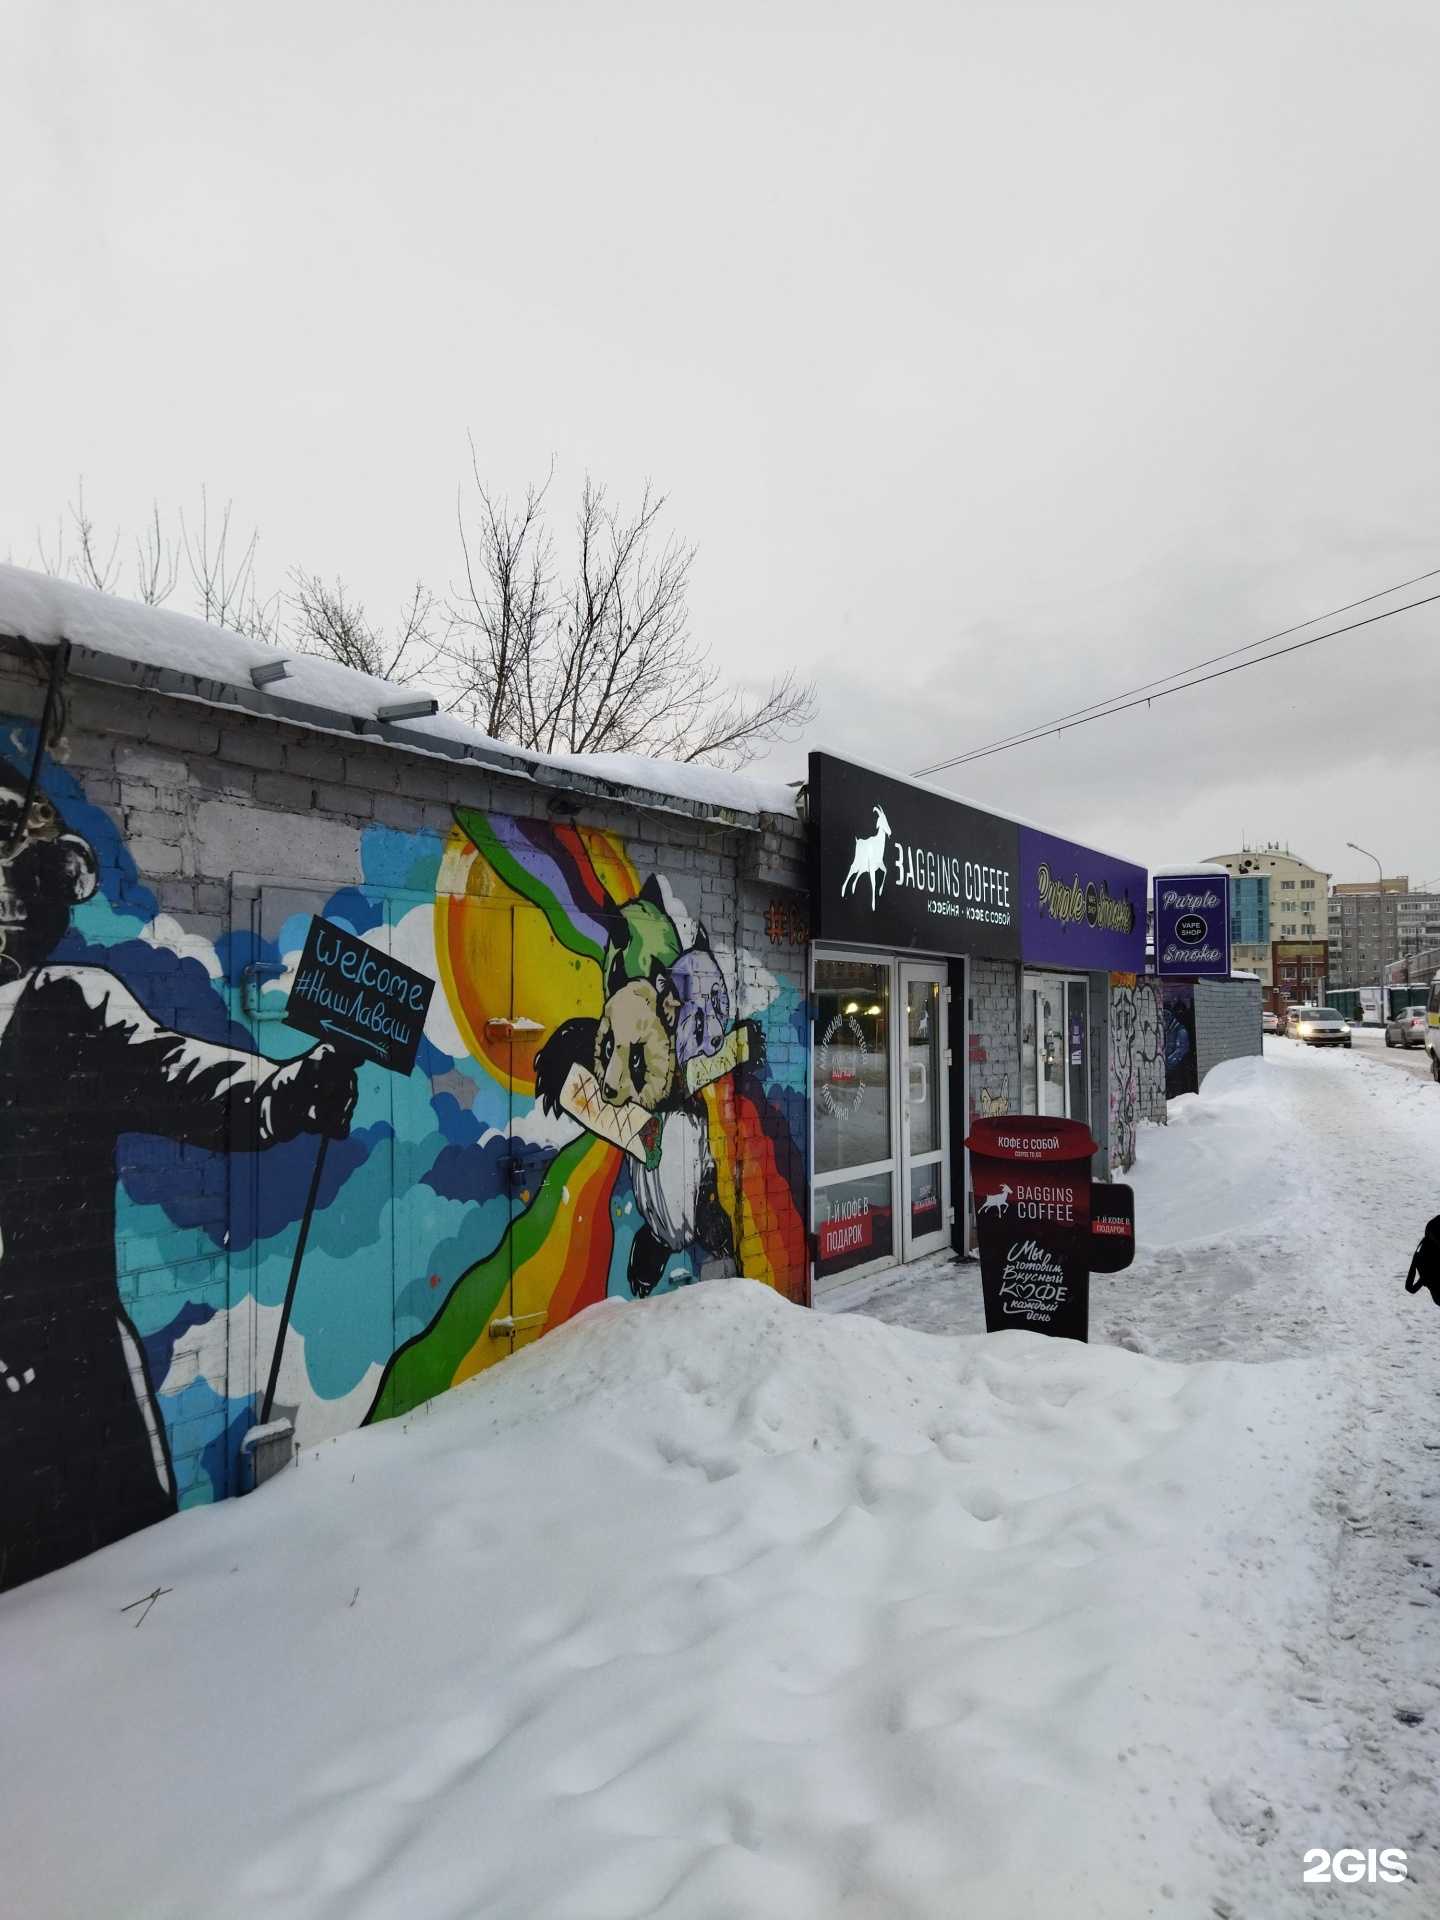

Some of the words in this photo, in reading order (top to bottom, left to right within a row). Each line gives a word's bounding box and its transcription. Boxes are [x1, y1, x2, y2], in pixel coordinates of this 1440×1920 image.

[895, 842, 960, 898] BAGGINS
[964, 862, 1010, 908] COFFEE
[1163, 889, 1218, 913] Purple
[927, 900, 960, 917] КОФЕЙНЯ
[965, 906, 984, 922] КОФЕ
[990, 911, 1011, 926] СОБОЙ
[1163, 944, 1222, 963] Smoke
[316, 930, 424, 1011] Welcome
[296, 969, 411, 1044] #НашЛаваш
[998, 1136, 1021, 1149] КОФЕ
[1023, 1138, 1029, 1149] С
[1030, 1136, 1060, 1150] СОБОЙ
[1017, 1185, 1073, 1203] BAGGINS
[841, 1199, 862, 1222] КОФЕ
[863, 1197, 869, 1216] В
[1017, 1201, 1074, 1222] COFFEE
[826, 1223, 863, 1253] ПОДАРОК
[1007, 1240, 1044, 1261] Мы
[1003, 1265, 1064, 1284] Вкусный
[1010, 1299, 1058, 1311] каждый
